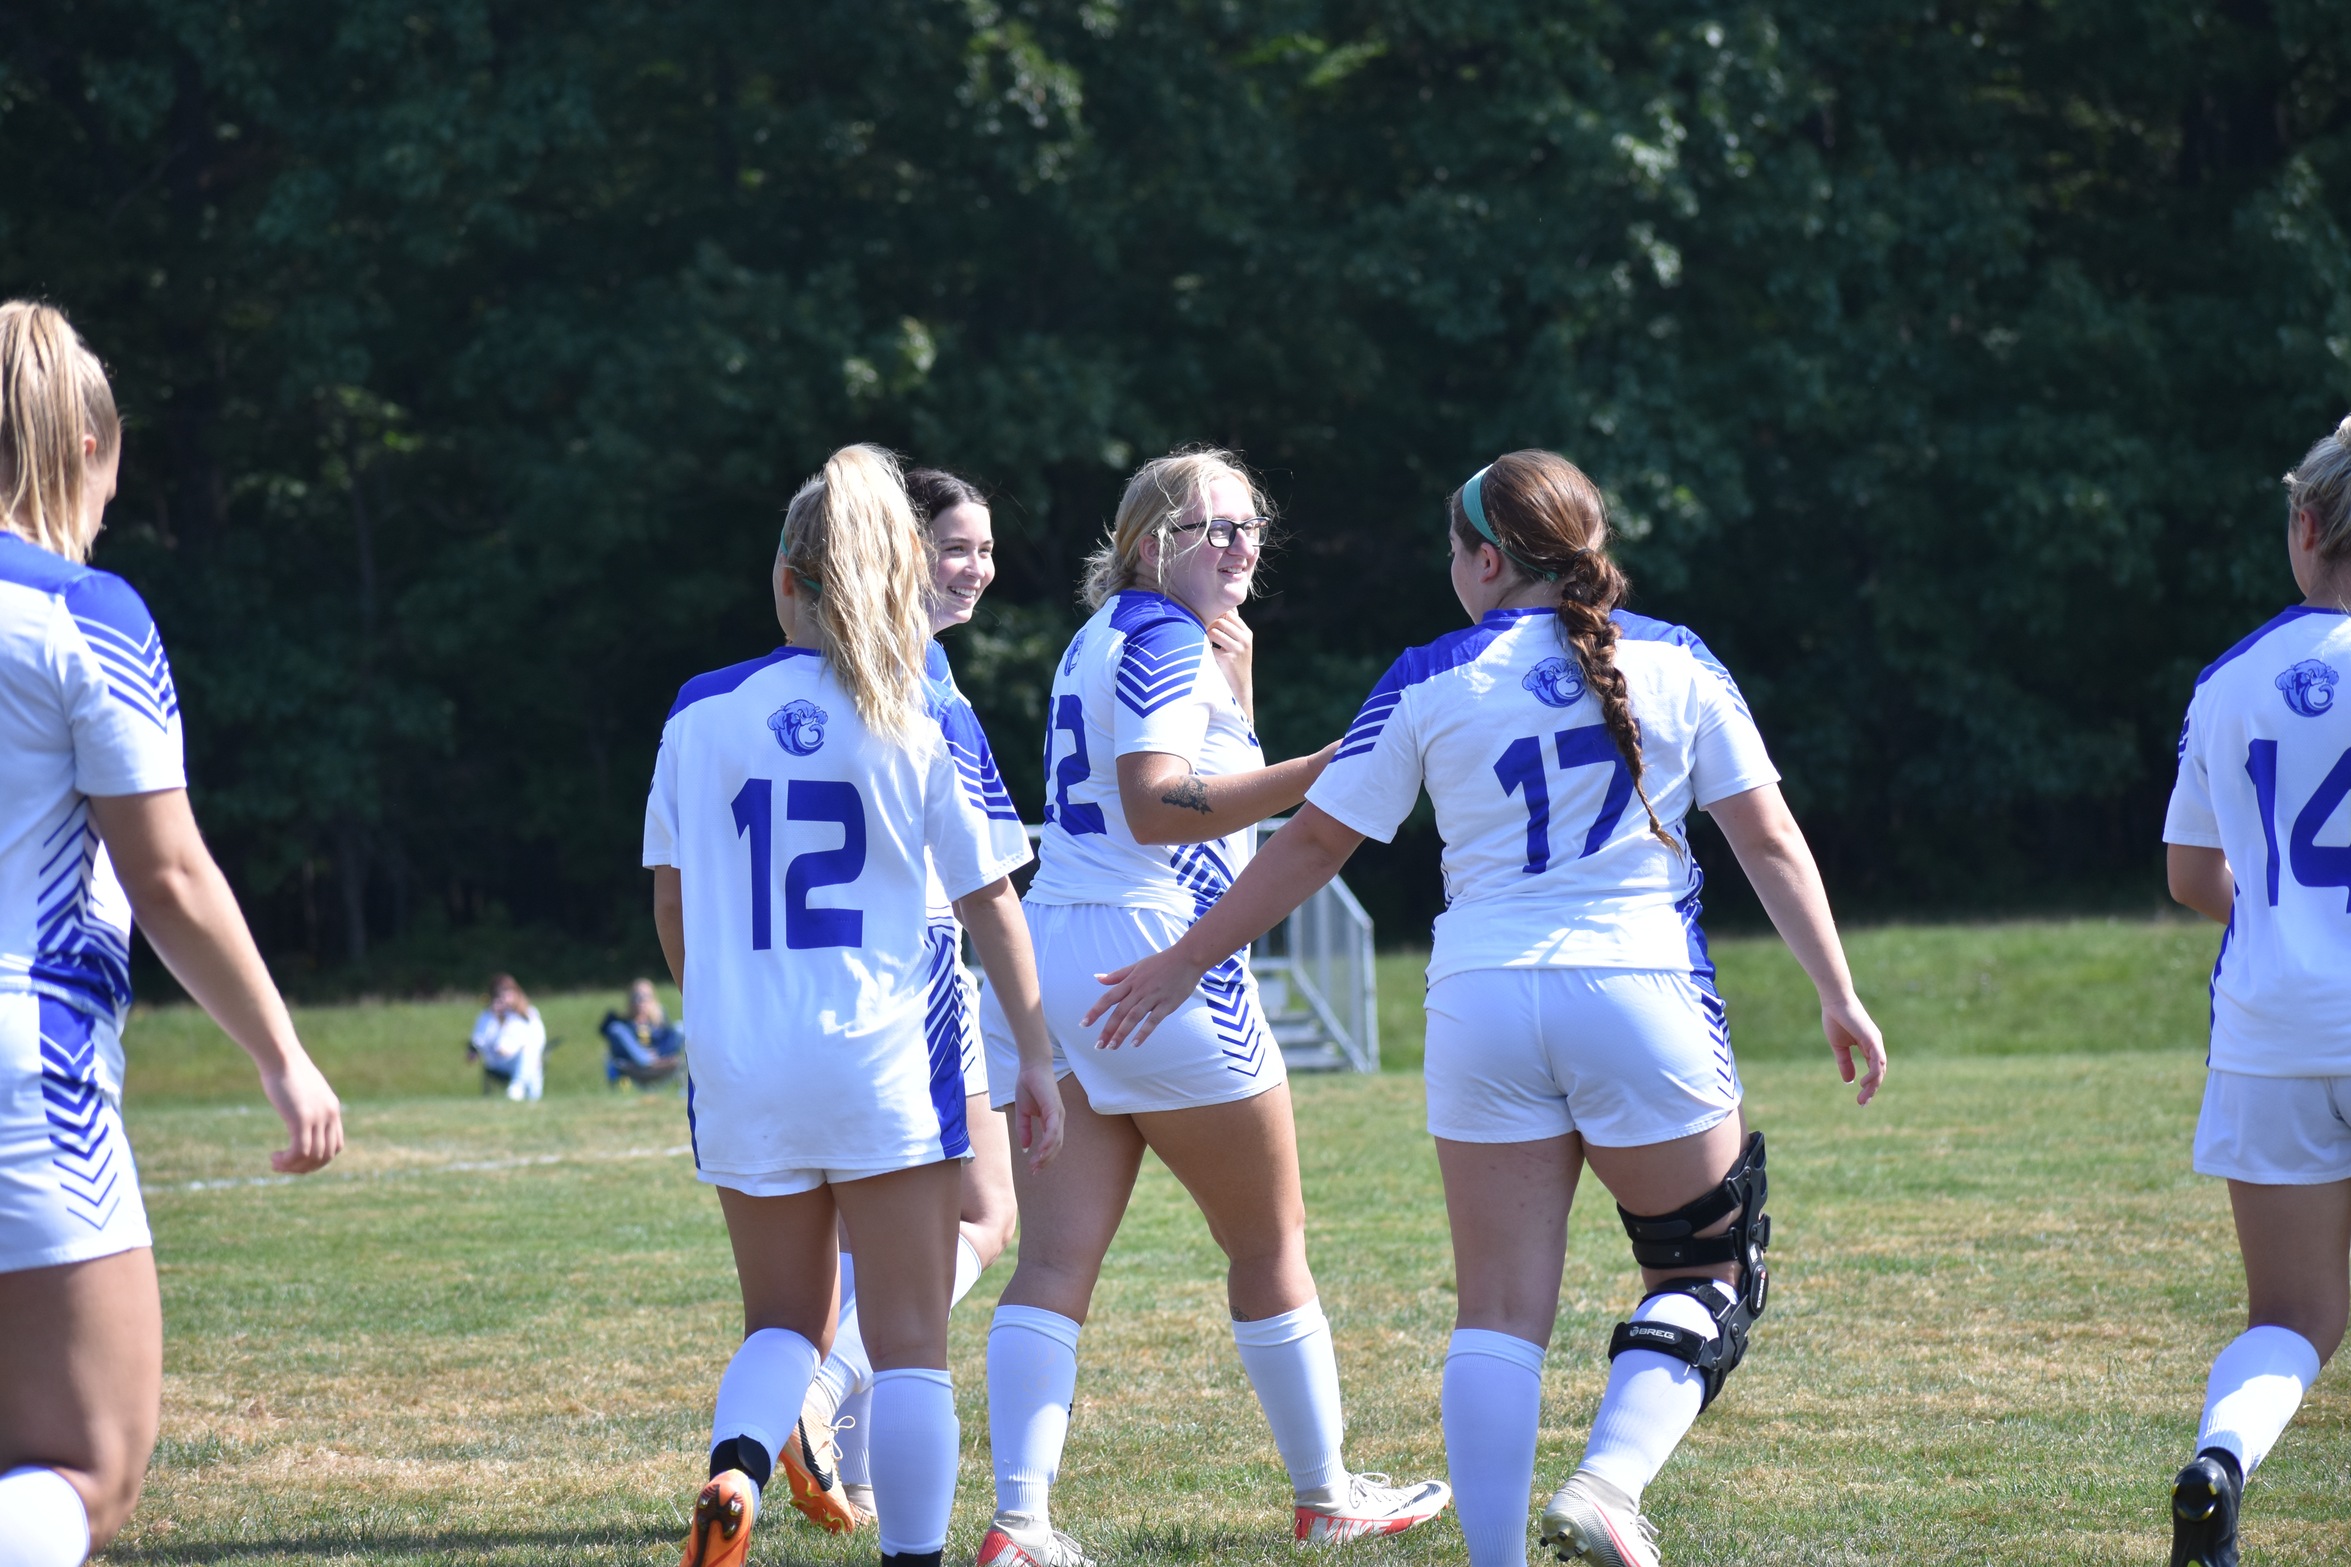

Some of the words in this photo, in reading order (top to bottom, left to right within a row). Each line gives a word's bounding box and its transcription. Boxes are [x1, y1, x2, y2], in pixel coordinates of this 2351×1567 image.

[1044, 694, 1107, 835] 2
[1494, 718, 1642, 874] 17
[2245, 738, 2351, 913] 14
[731, 778, 866, 950] 12
[1638, 1328, 1675, 1340] BREG
